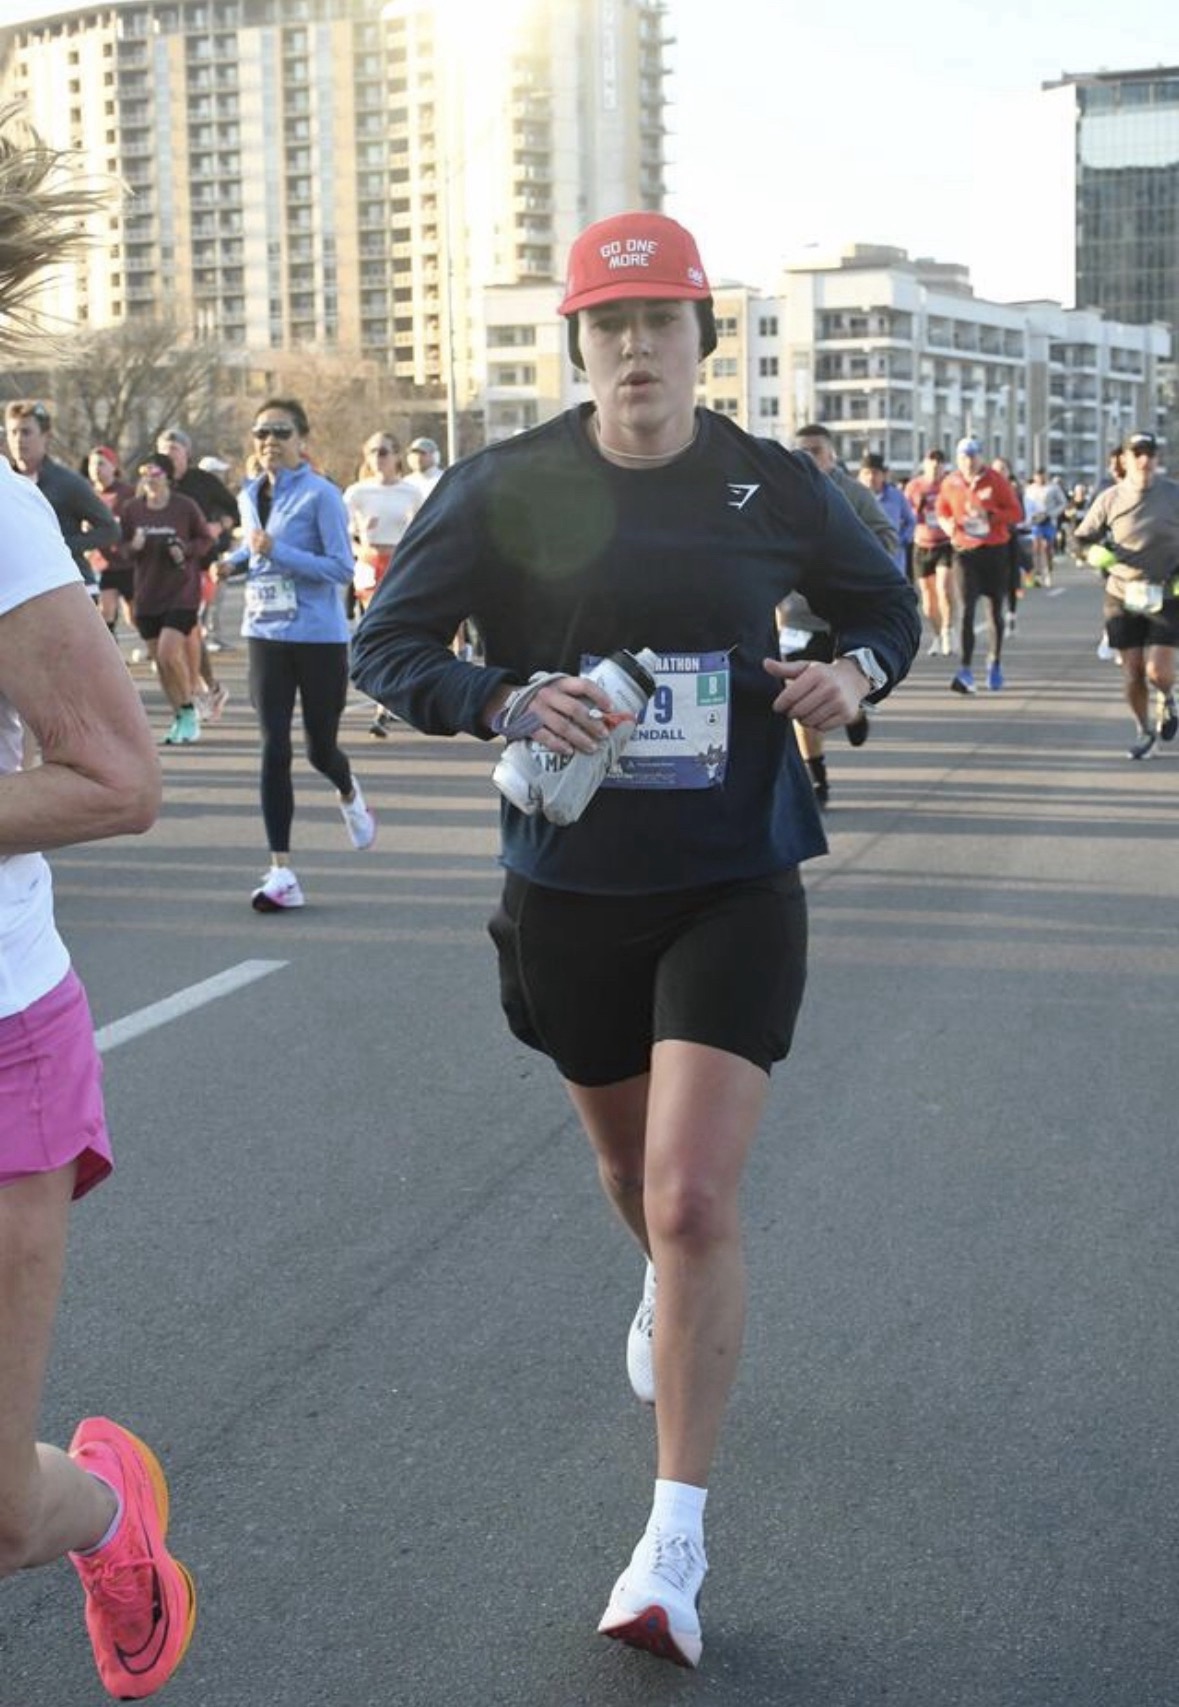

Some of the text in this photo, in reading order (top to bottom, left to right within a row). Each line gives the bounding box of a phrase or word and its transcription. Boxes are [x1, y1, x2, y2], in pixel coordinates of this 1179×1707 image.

[600, 239, 658, 258] GO ONE
[609, 254, 650, 270] MORE
[655, 657, 700, 672] RATHON
[630, 729, 686, 741] ENDALL
